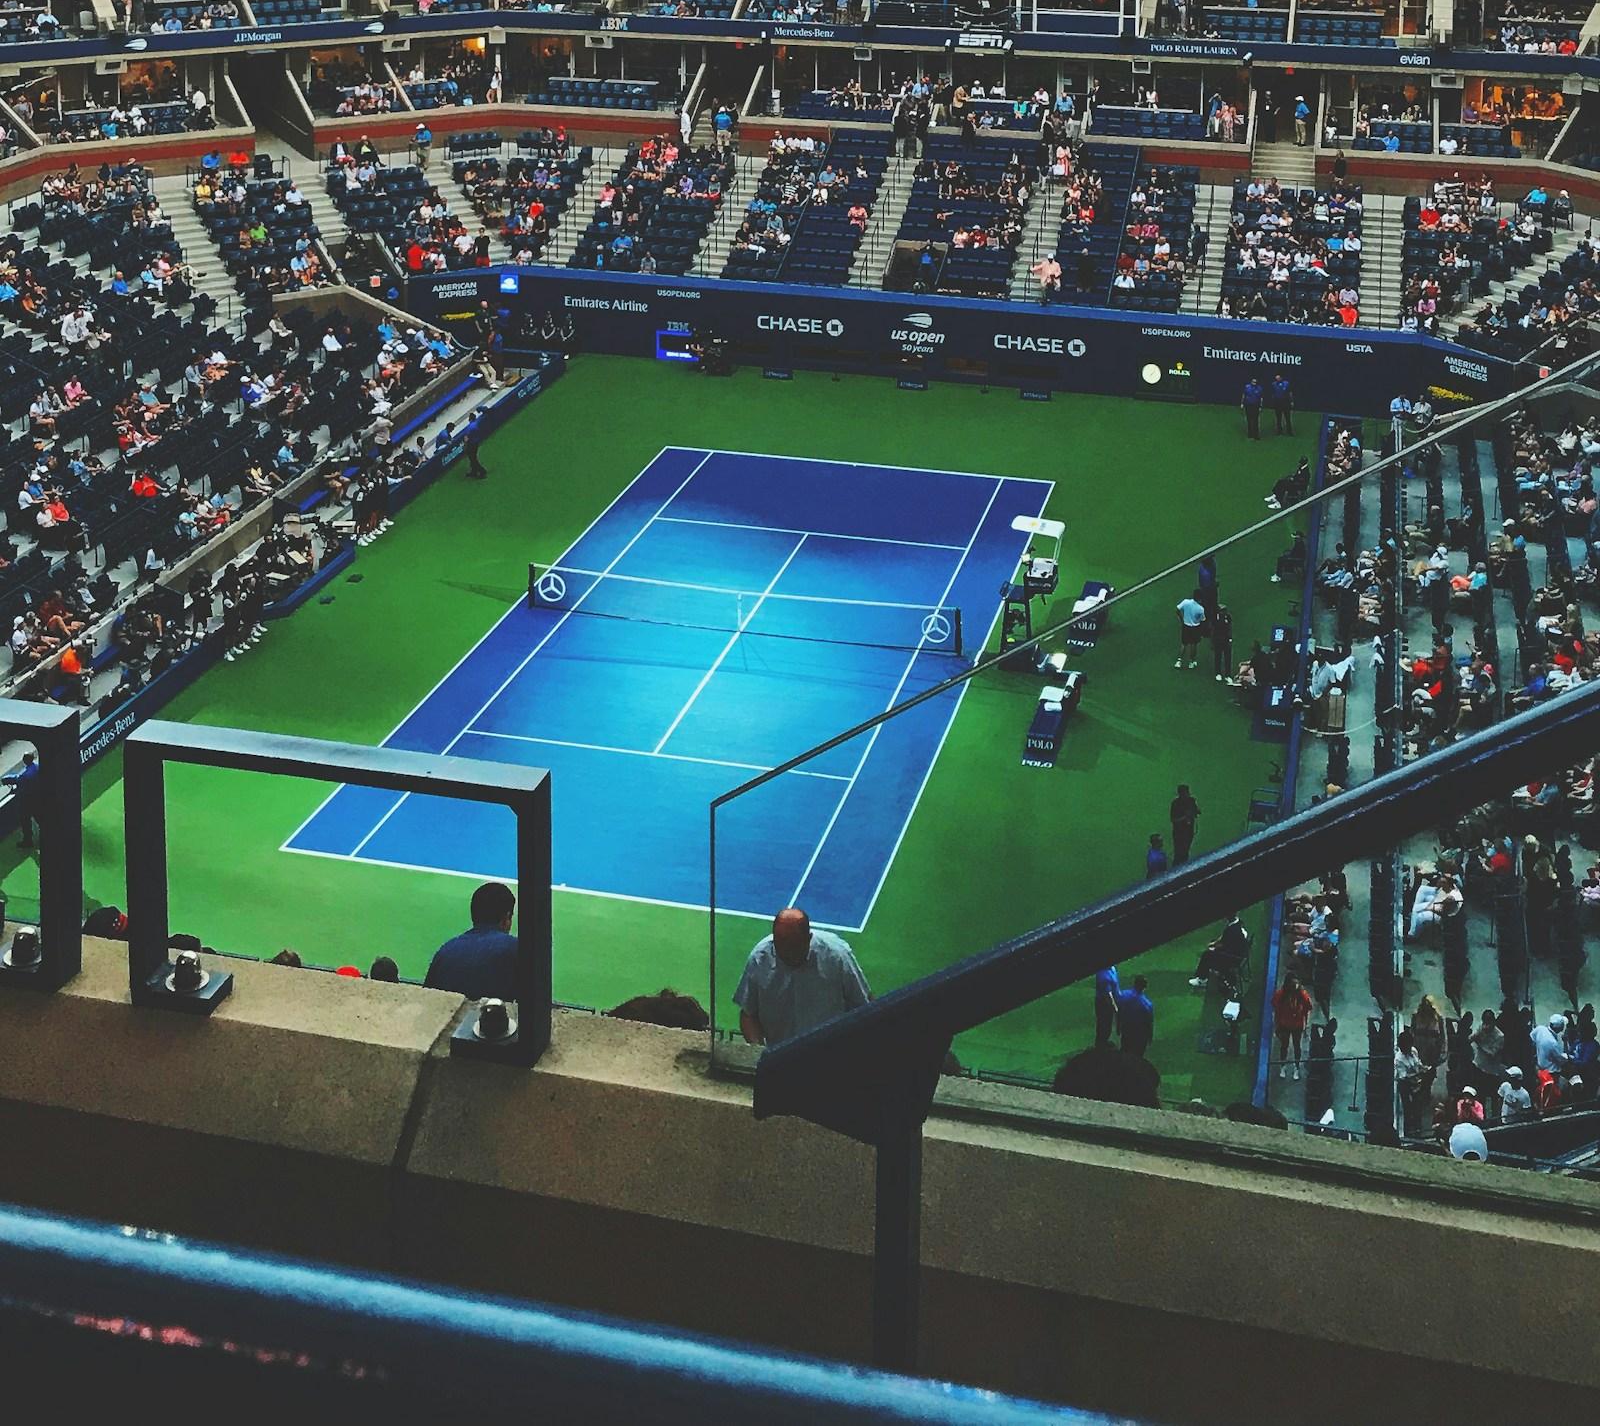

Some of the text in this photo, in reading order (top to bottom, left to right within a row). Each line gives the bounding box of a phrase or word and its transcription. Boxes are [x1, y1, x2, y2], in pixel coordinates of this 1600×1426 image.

[600, 18, 628, 31] IBM
[234, 32, 282, 43] J.P.Morgan
[774, 26, 835, 38] Mercedes-Benz
[958, 33, 1004, 47] ESPN
[1150, 44, 1238, 55] POLO RALPH LAUREN
[1400, 53, 1430, 65] evian
[432, 281, 477, 293] AMERICAN
[438, 288, 478, 299] EXPRESS
[657, 289, 701, 299] USOPEN.ORG
[564, 295, 648, 313] Emirates Airline
[667, 321, 690, 333] IBM
[756, 315, 823, 335] CHASE
[891, 329, 945, 345] us open
[1141, 327, 1192, 339] USOPEN.ORG
[901, 343, 934, 353] 50 years
[993, 334, 1064, 354] CHASE
[1345, 343, 1374, 354] USTA
[1203, 345, 1302, 366] Emirates Airline
[1443, 355, 1488, 374] AMERICAN
[1168, 368, 1191, 377] ROLEX
[1449, 365, 1488, 382] EXPRESS
[80, 711, 136, 764] ercedes-Benz
[1027, 738, 1054, 750] POLO
[1021, 759, 1053, 769] POLO
